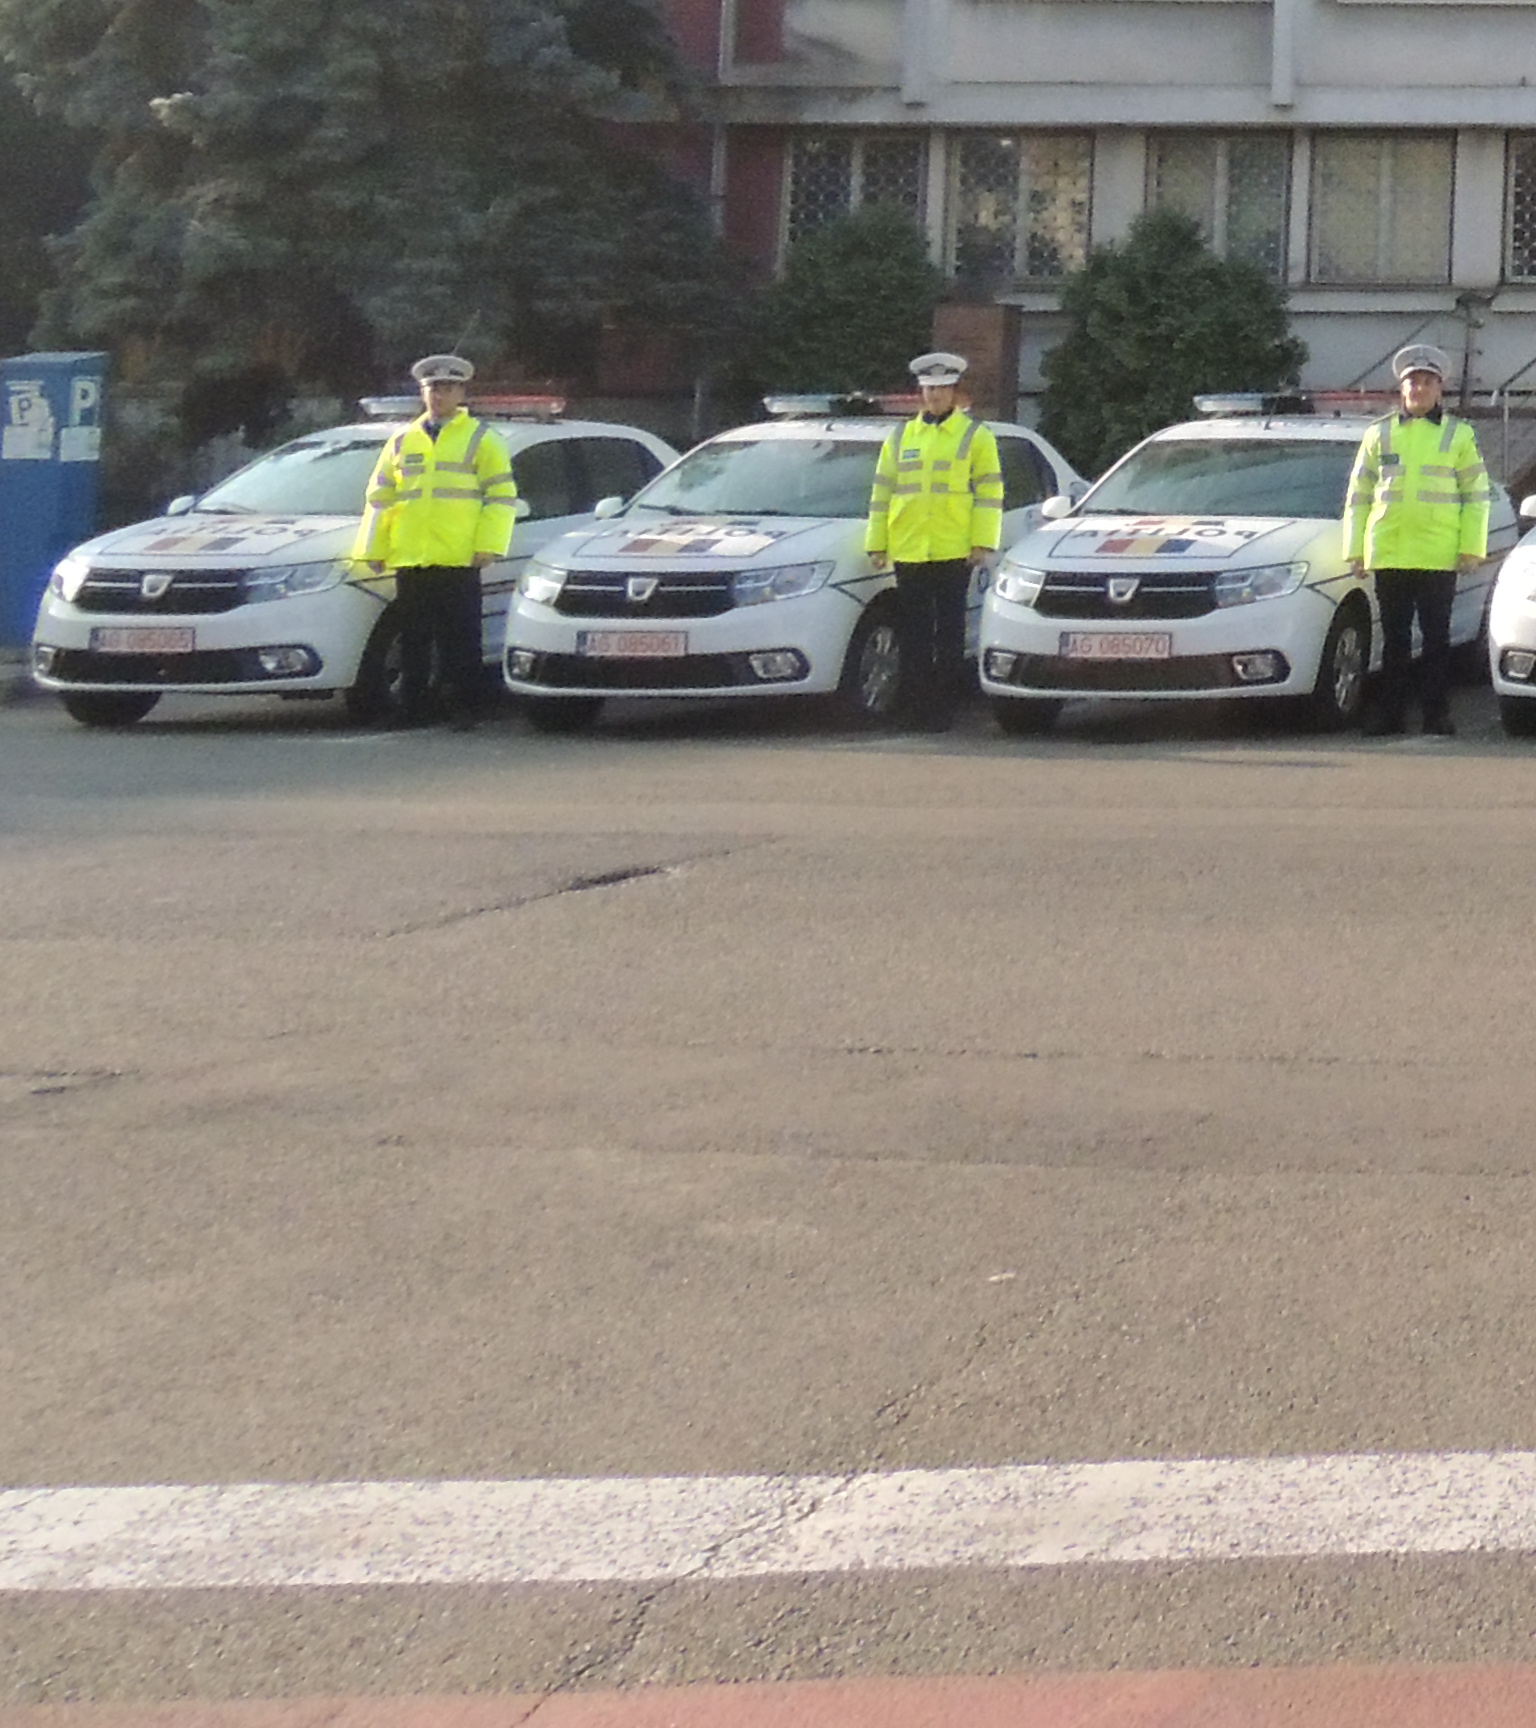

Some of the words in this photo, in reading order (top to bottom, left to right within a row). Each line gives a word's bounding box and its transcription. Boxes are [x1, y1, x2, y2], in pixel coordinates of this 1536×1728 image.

[588, 633, 611, 653] AG
[1069, 636, 1093, 654] AG
[1099, 636, 1165, 654] 085070
